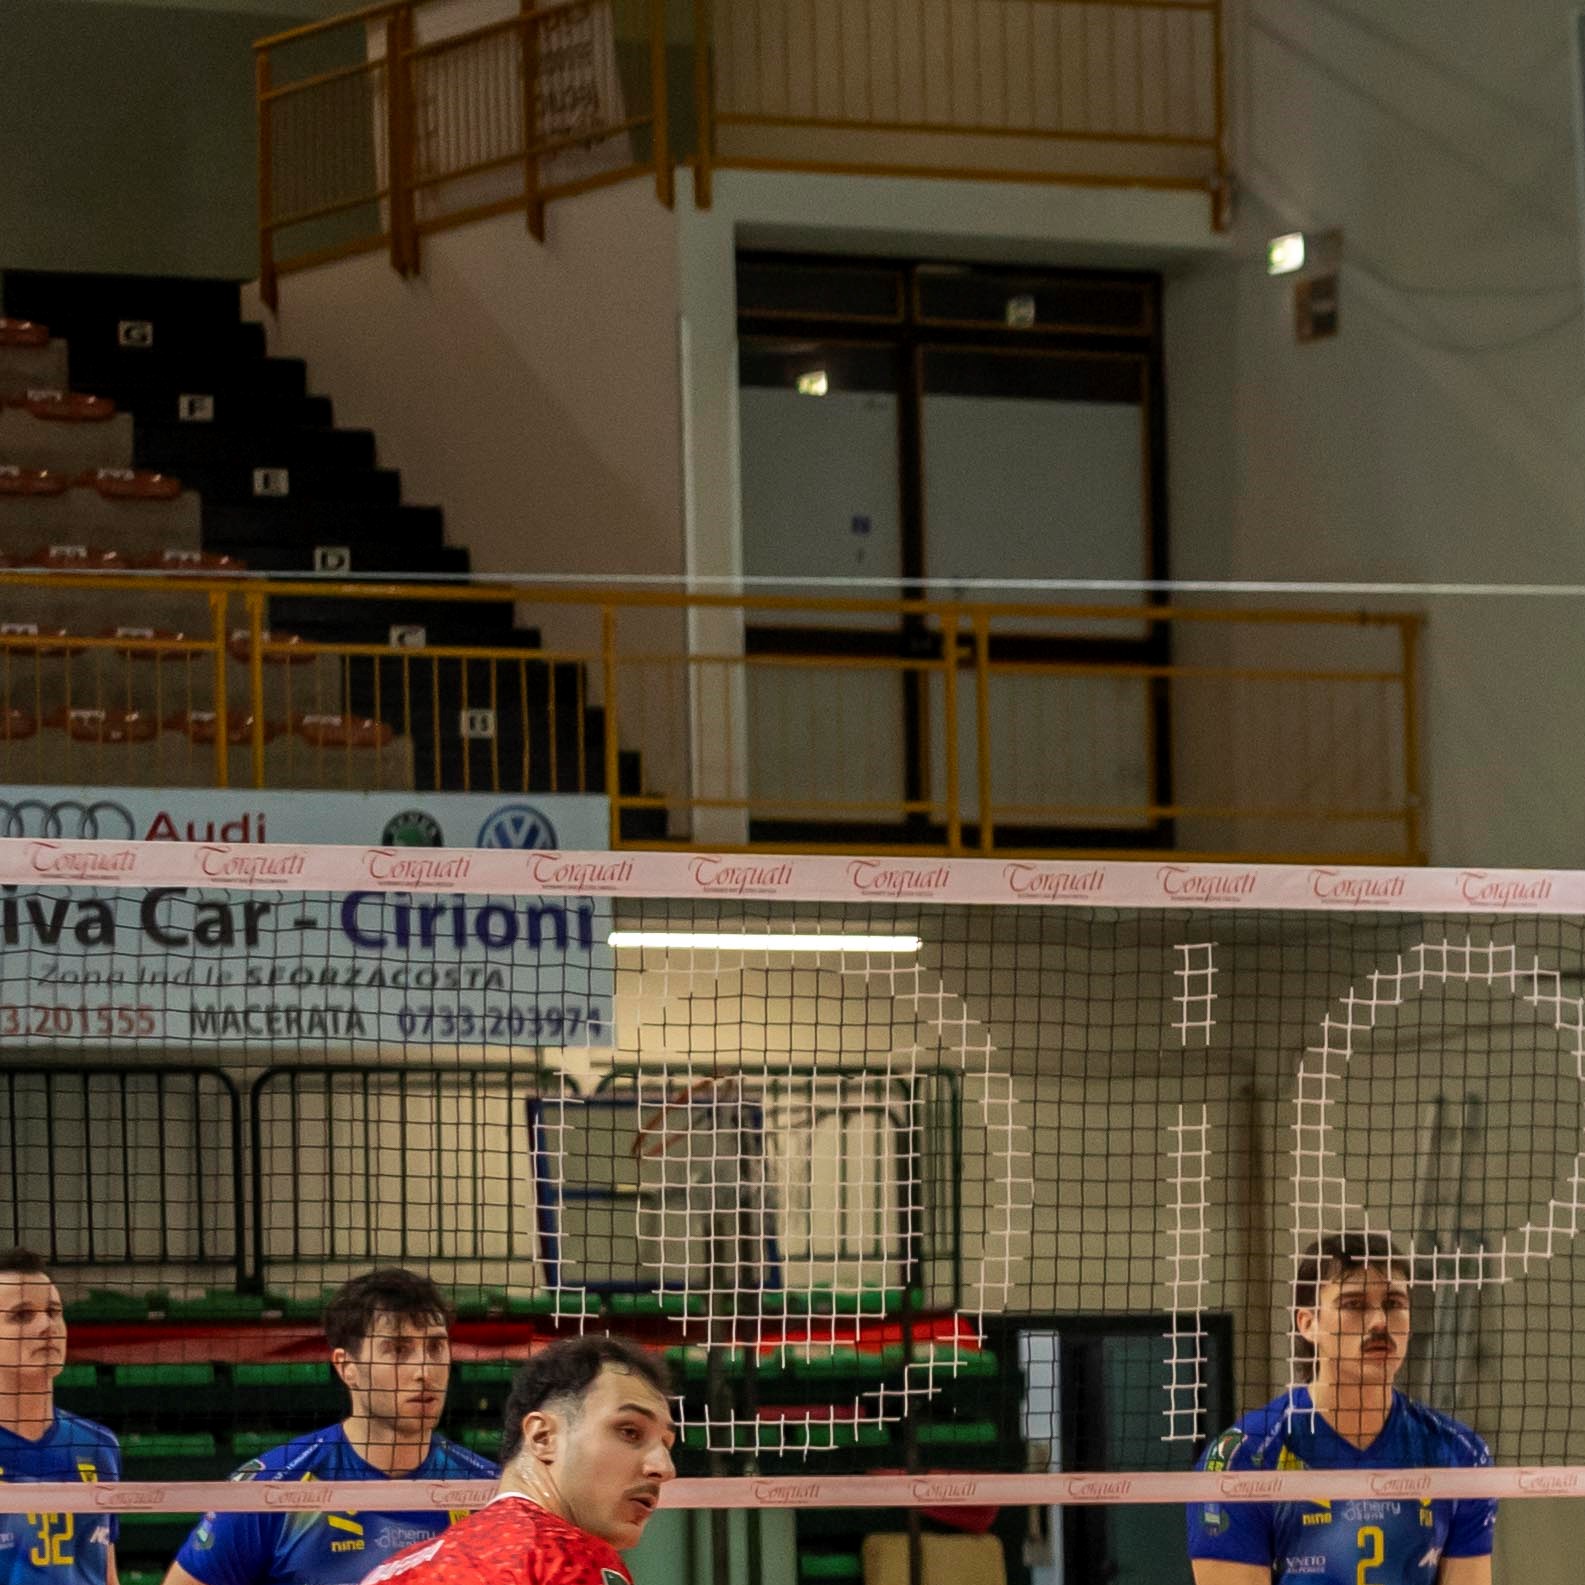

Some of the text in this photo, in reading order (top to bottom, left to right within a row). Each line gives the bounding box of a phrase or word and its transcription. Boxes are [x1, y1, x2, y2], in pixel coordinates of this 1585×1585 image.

[145, 812, 266, 842] Audi
[23, 841, 138, 876] Torquati
[194, 845, 307, 884] Torquati
[362, 847, 473, 887] Torquati
[526, 851, 634, 890] Torquati
[687, 855, 794, 893] Torquati
[846, 857, 953, 896] Torquati
[1000, 863, 1105, 899] Torquati
[1157, 865, 1258, 901] Torquati
[1305, 867, 1407, 905] Torquati
[1455, 870, 1552, 907] Torquati
[142, 888, 271, 947] Car
[341, 891, 593, 951] Cirioni
[247, 964, 507, 991] SFORZACOSTA
[190, 1004, 367, 1038] MACERATA
[28, 1511, 74, 1566] 32
[331, 1537, 366, 1553] nine
